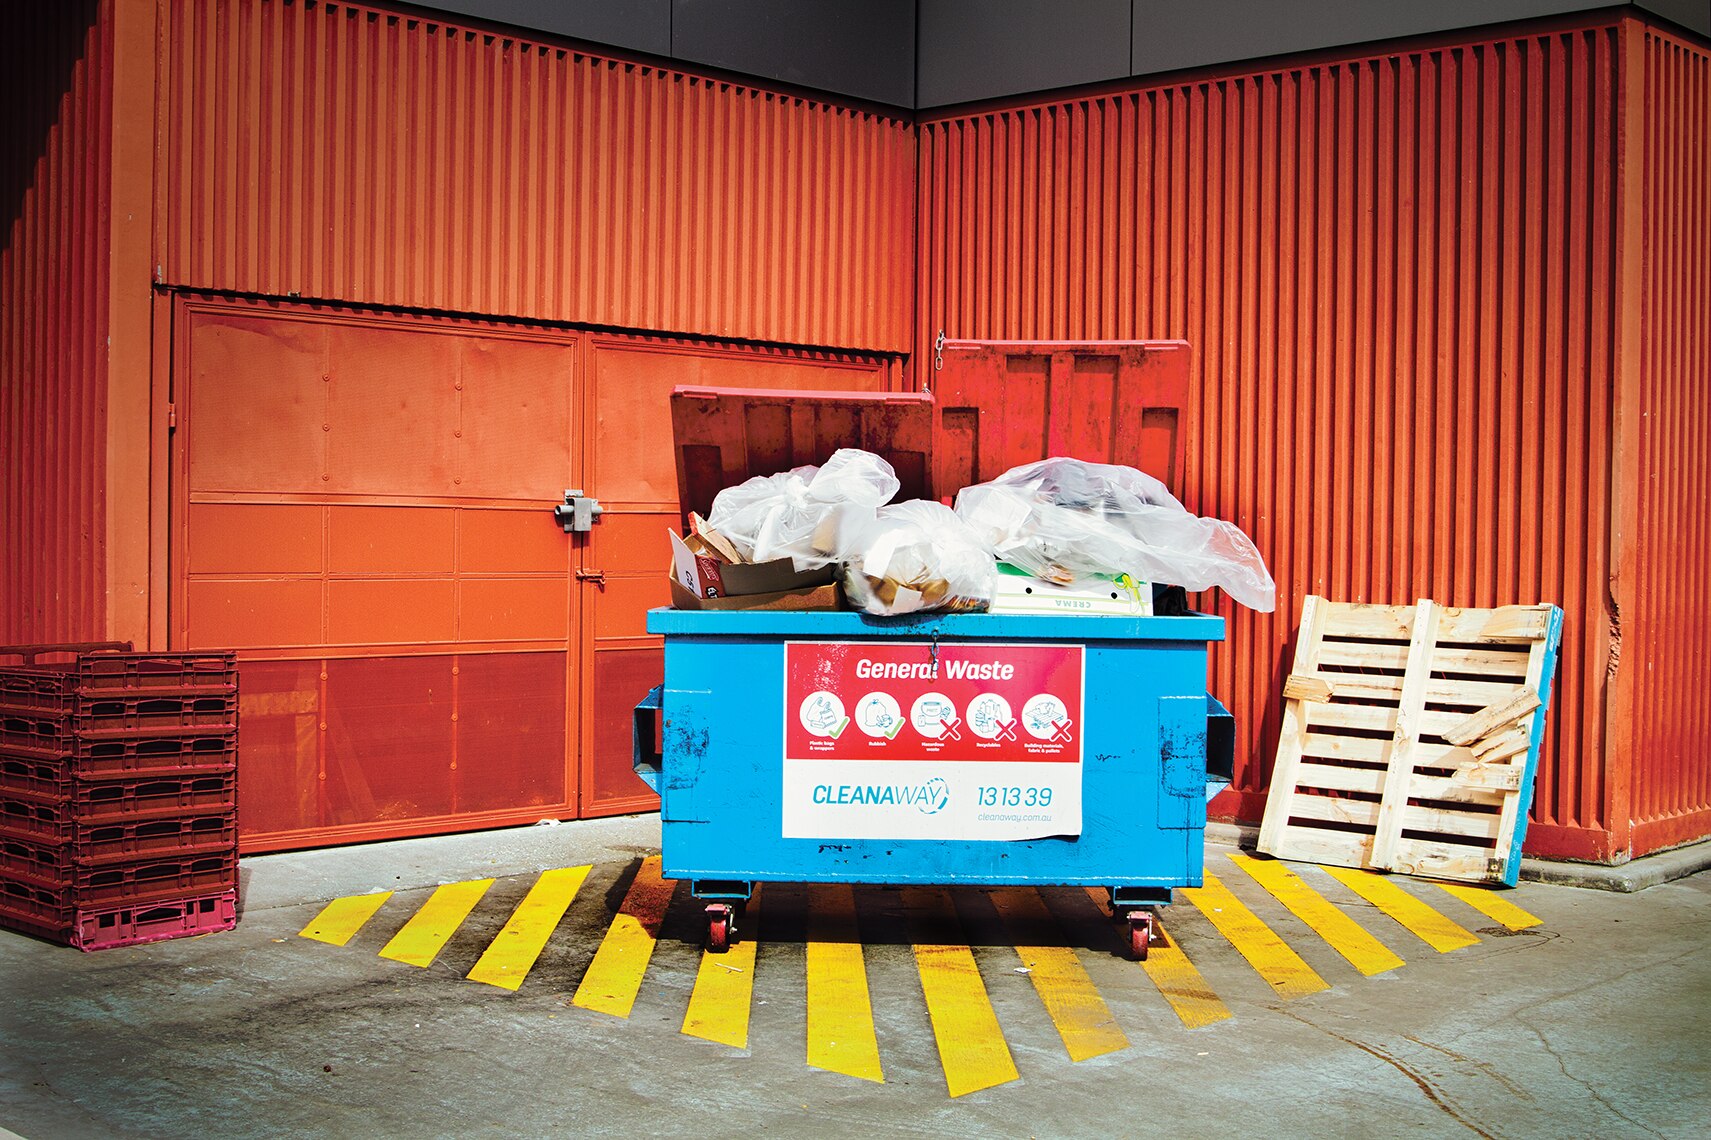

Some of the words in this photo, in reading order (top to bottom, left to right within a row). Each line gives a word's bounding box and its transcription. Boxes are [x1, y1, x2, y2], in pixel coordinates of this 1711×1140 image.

[1055, 599, 1092, 609] CREMA
[856, 658, 939, 680] General
[945, 659, 1014, 680] Waste
[812, 784, 942, 805] CLEANAWAY
[978, 786, 997, 806] 13
[1002, 787, 1020, 806] 13
[1024, 787, 1053, 807] 39
[977, 812, 1052, 823] cleanaway.com.au
